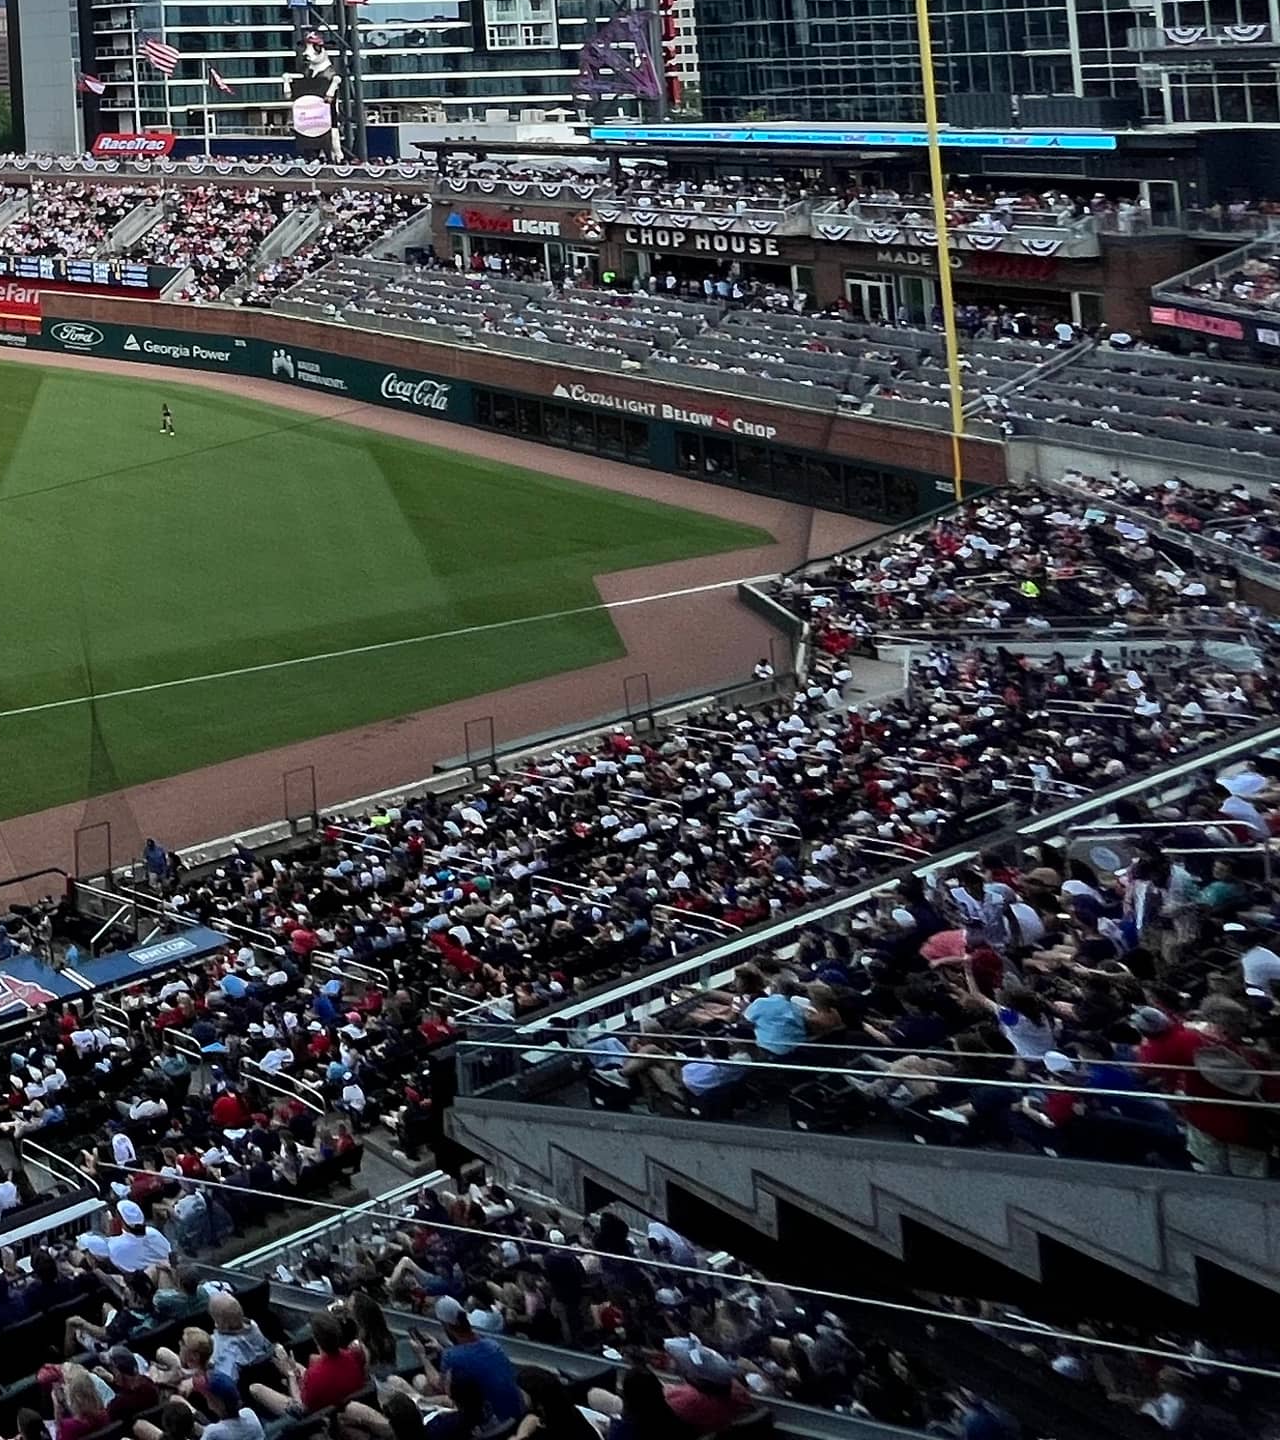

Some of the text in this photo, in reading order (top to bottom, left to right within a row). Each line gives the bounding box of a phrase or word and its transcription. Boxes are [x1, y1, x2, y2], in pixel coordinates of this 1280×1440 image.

[98, 137, 165, 150] RaceTrac
[513, 219, 560, 236] LIGHT
[625, 228, 780, 257] CHOP HOUSE
[877, 251, 933, 266] MADE
[60, 324, 94, 344] Ford
[144, 341, 231, 362] Georgia Power
[615, 398, 656, 417] LIGHT
[662, 404, 713, 427] BELOW
[733, 419, 777, 440] CHOP
